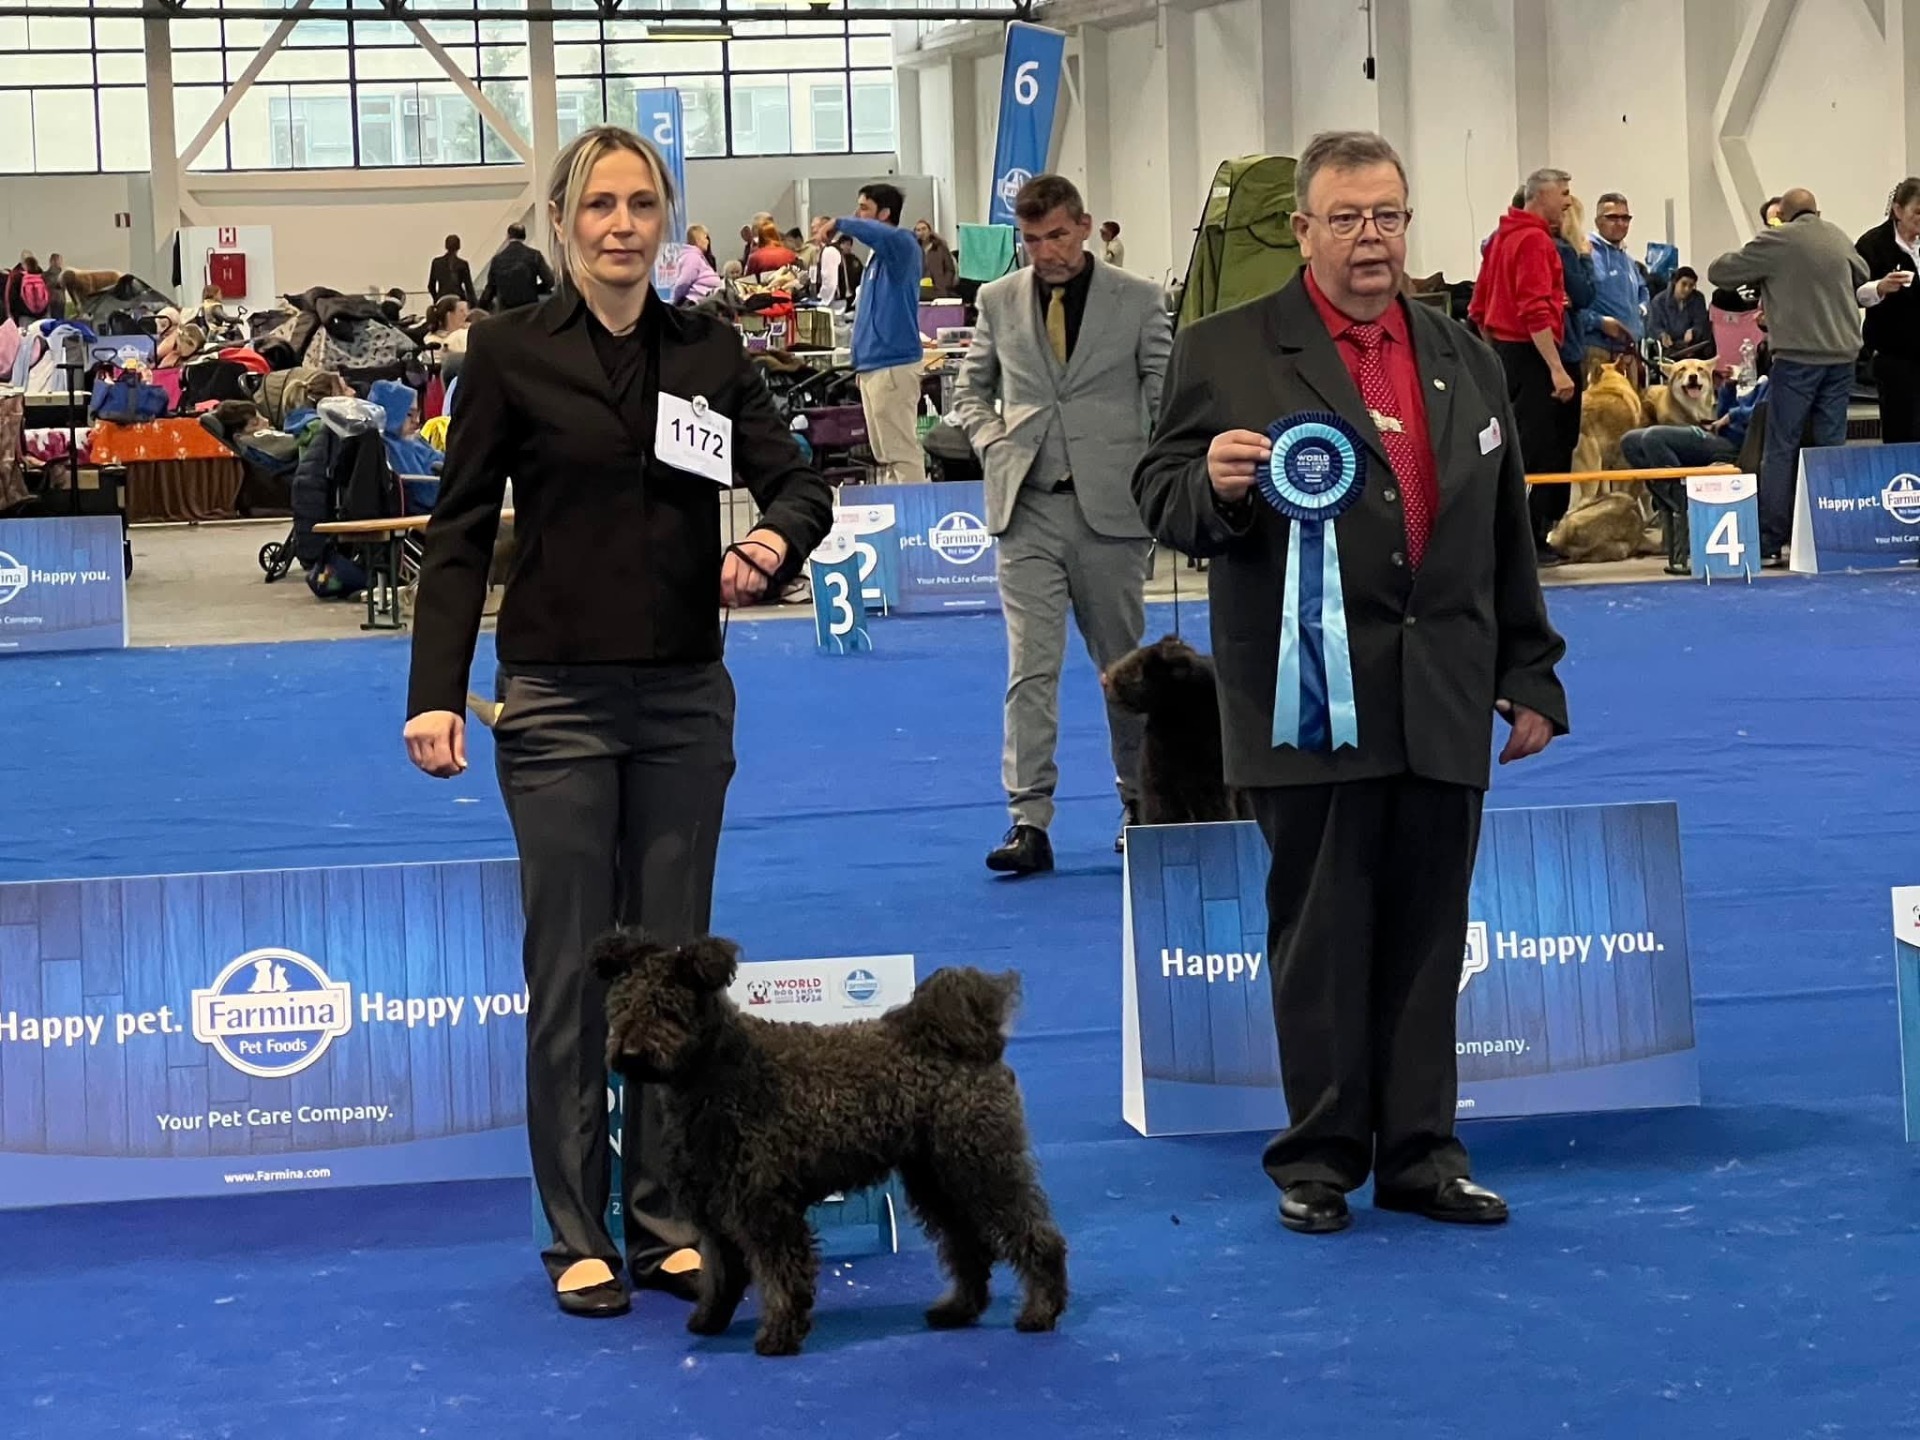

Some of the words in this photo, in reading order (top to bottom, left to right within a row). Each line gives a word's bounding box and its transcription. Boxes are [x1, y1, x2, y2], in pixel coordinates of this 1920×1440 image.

[1014, 61, 1039, 105] 6
[671, 418, 723, 459] 1172
[1818, 497, 1854, 511] Happy
[1858, 496, 1880, 510] pet.
[1888, 492, 1920, 505] Farmin
[899, 534, 926, 550] pet.
[936, 533, 986, 544] Farmina
[1706, 511, 1745, 566] 4
[31, 570, 76, 585] Happy
[81, 571, 110, 584] you.
[824, 572, 854, 635] 3
[1496, 931, 1592, 965] Happy
[1600, 932, 1665, 962] you.
[1161, 948, 1262, 983] Happy
[773, 978, 821, 989] WORLD
[209, 998, 335, 1030] Farmina
[360, 992, 465, 1028] Happy
[0, 1011, 104, 1048] Happy
[116, 1005, 182, 1044] pet.
[239, 1040, 263, 1055] Pet
[266, 1038, 308, 1053] Foods
[1455, 1038, 1531, 1056] ompany.
[157, 1114, 203, 1131] Your
[209, 1111, 242, 1128] Pet
[247, 1108, 292, 1126] Care
[298, 1105, 394, 1124] Company.
[224, 1168, 331, 1183] www.Farmina.com
